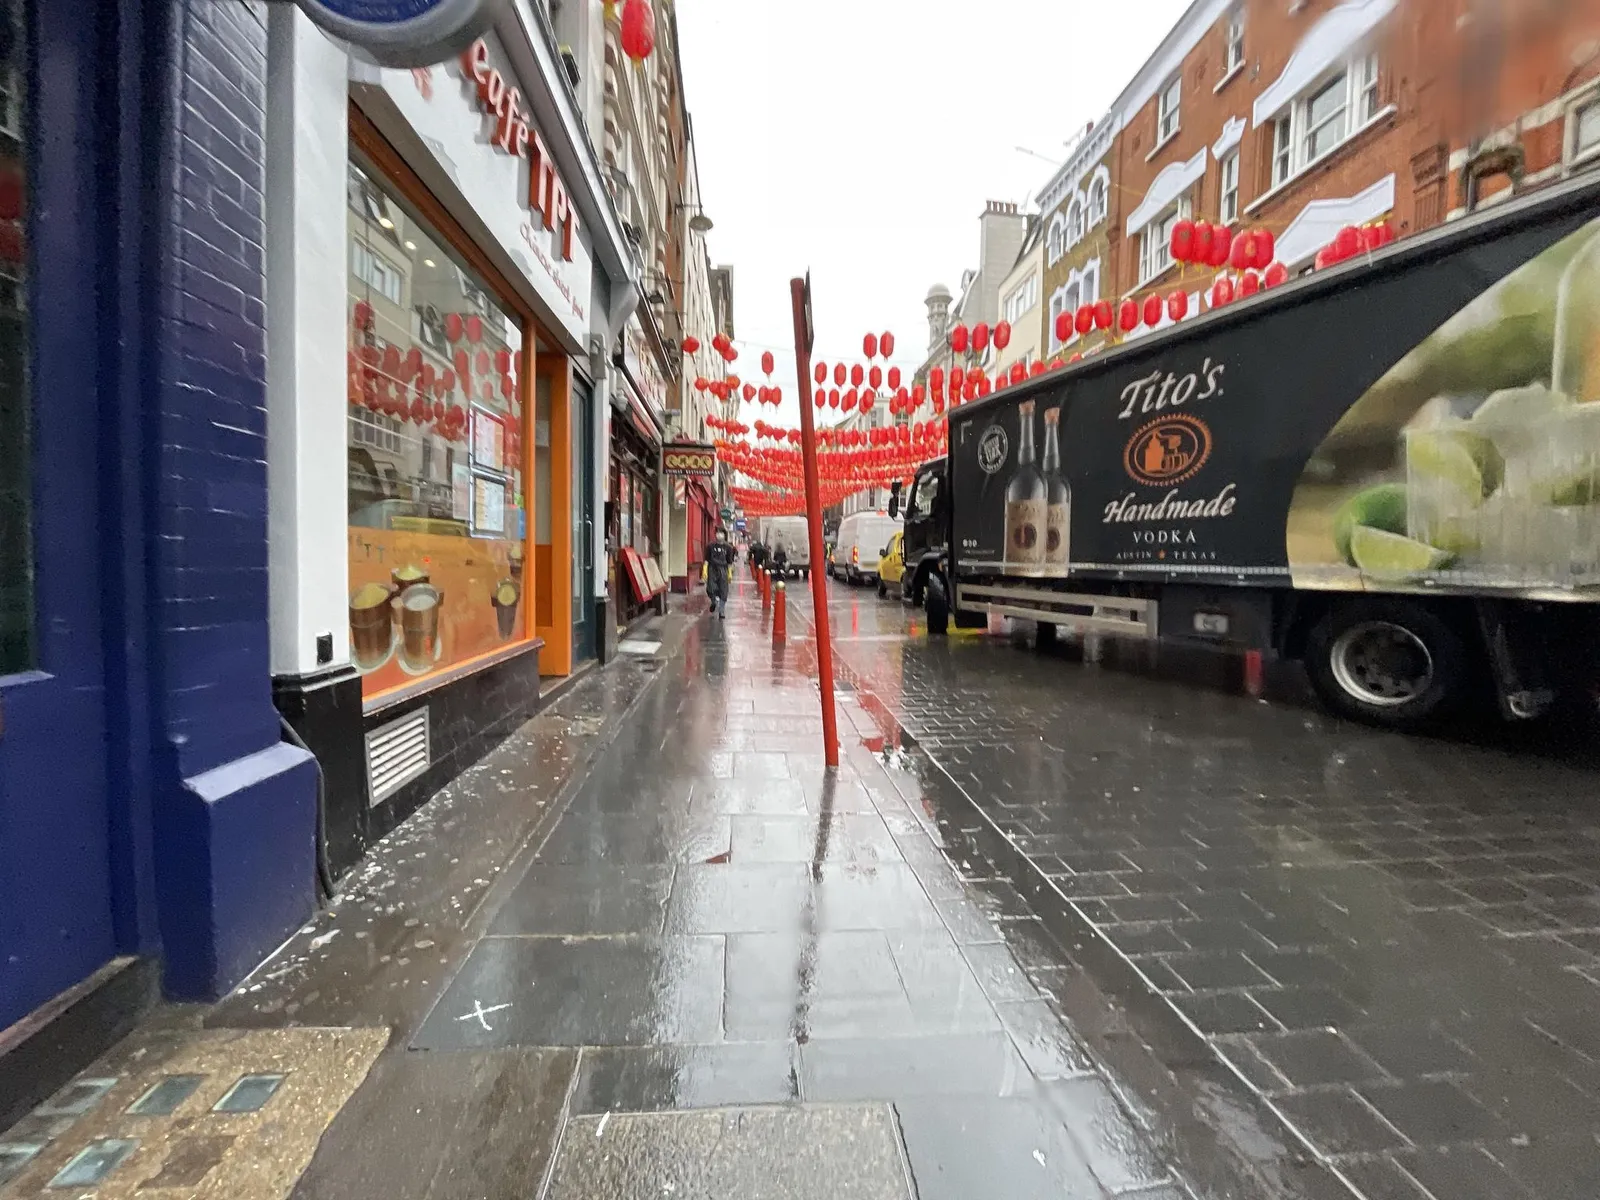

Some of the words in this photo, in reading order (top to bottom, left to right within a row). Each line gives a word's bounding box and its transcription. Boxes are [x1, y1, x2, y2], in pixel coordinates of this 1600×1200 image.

[531, 130, 581, 263] TPT
[1103, 483, 1237, 523] Handmade
[1132, 529, 1198, 544] VODKA
[1116, 551, 1152, 560] AUSTIN
[1173, 550, 1216, 560] TEXAS
